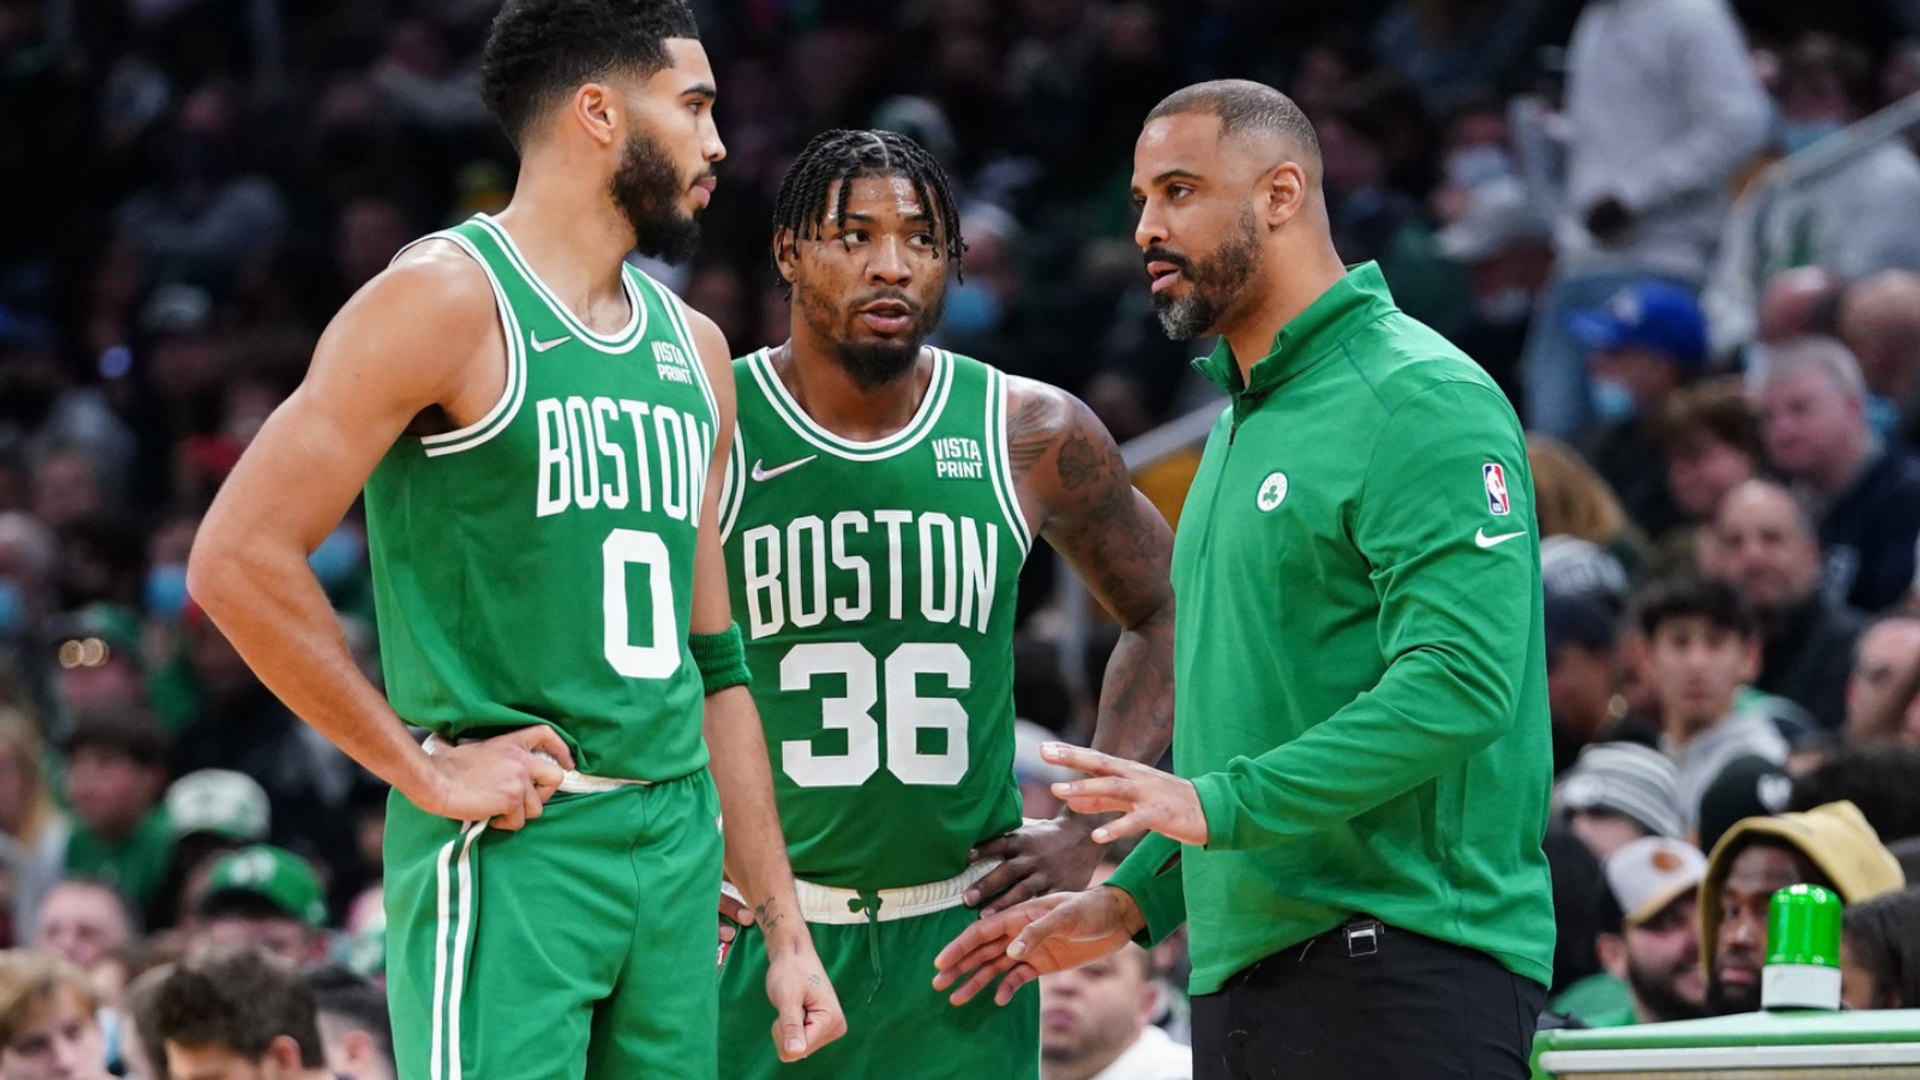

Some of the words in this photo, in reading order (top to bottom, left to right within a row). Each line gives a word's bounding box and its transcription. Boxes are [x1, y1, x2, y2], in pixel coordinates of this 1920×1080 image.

[651, 340, 689, 369] VISTA
[656, 363, 693, 385] PRINT
[536, 396, 710, 528] BOSTON
[931, 437, 982, 461] VISTA
[936, 461, 984, 479] PRINT
[602, 528, 681, 679] 0
[743, 509, 998, 640] BOSTON
[780, 641, 971, 787] 36
